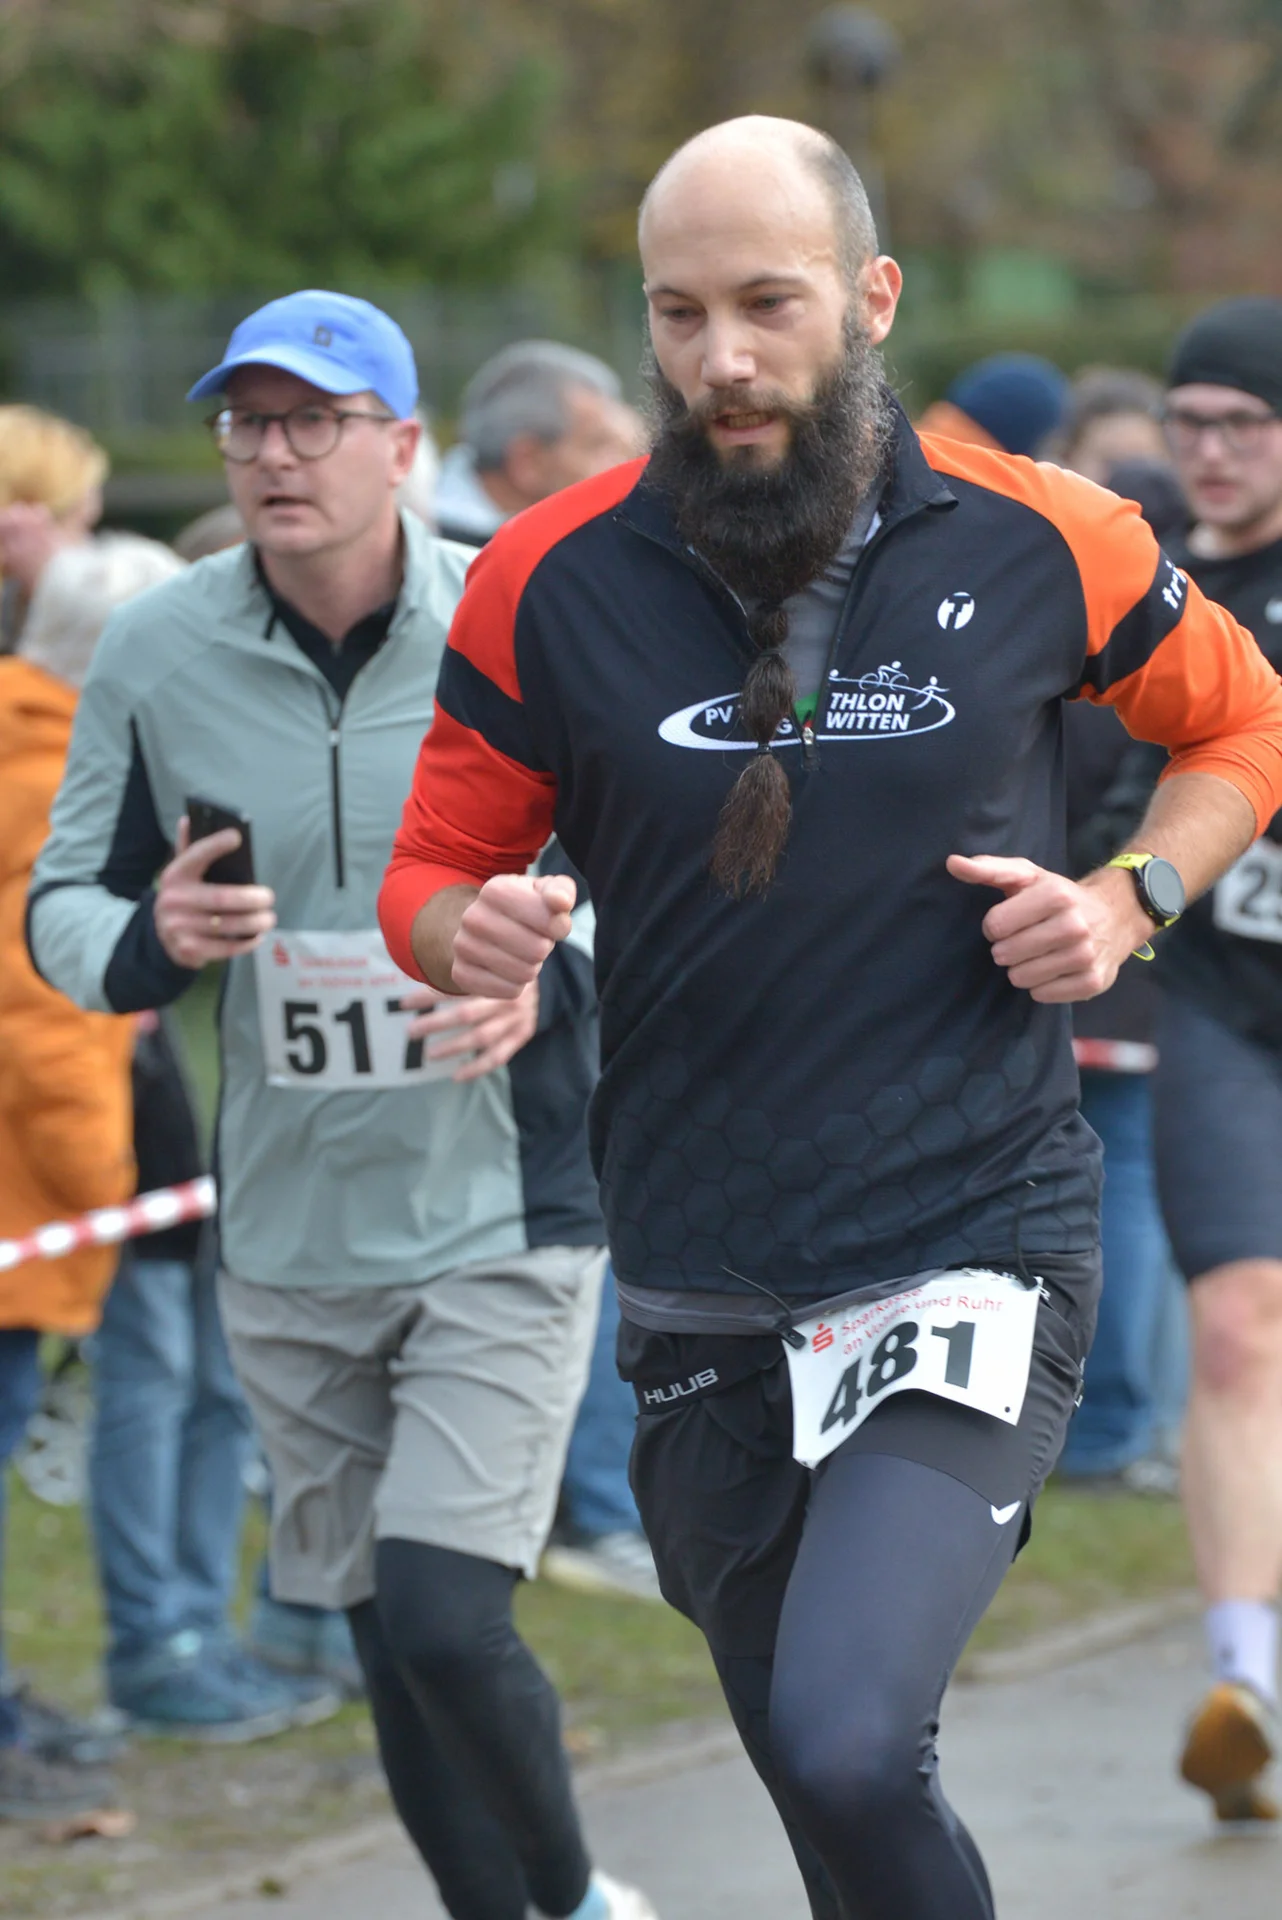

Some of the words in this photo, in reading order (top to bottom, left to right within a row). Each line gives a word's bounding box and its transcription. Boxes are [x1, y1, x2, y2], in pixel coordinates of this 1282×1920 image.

[829, 692, 906, 712] THLON
[775, 717, 793, 735] G
[825, 711, 911, 732] WITTEN
[841, 1288, 924, 1336] Sparkasse
[956, 1294, 1004, 1312] Ruhr
[643, 1367, 720, 1405] HUUB
[819, 1320, 977, 1436] 481
